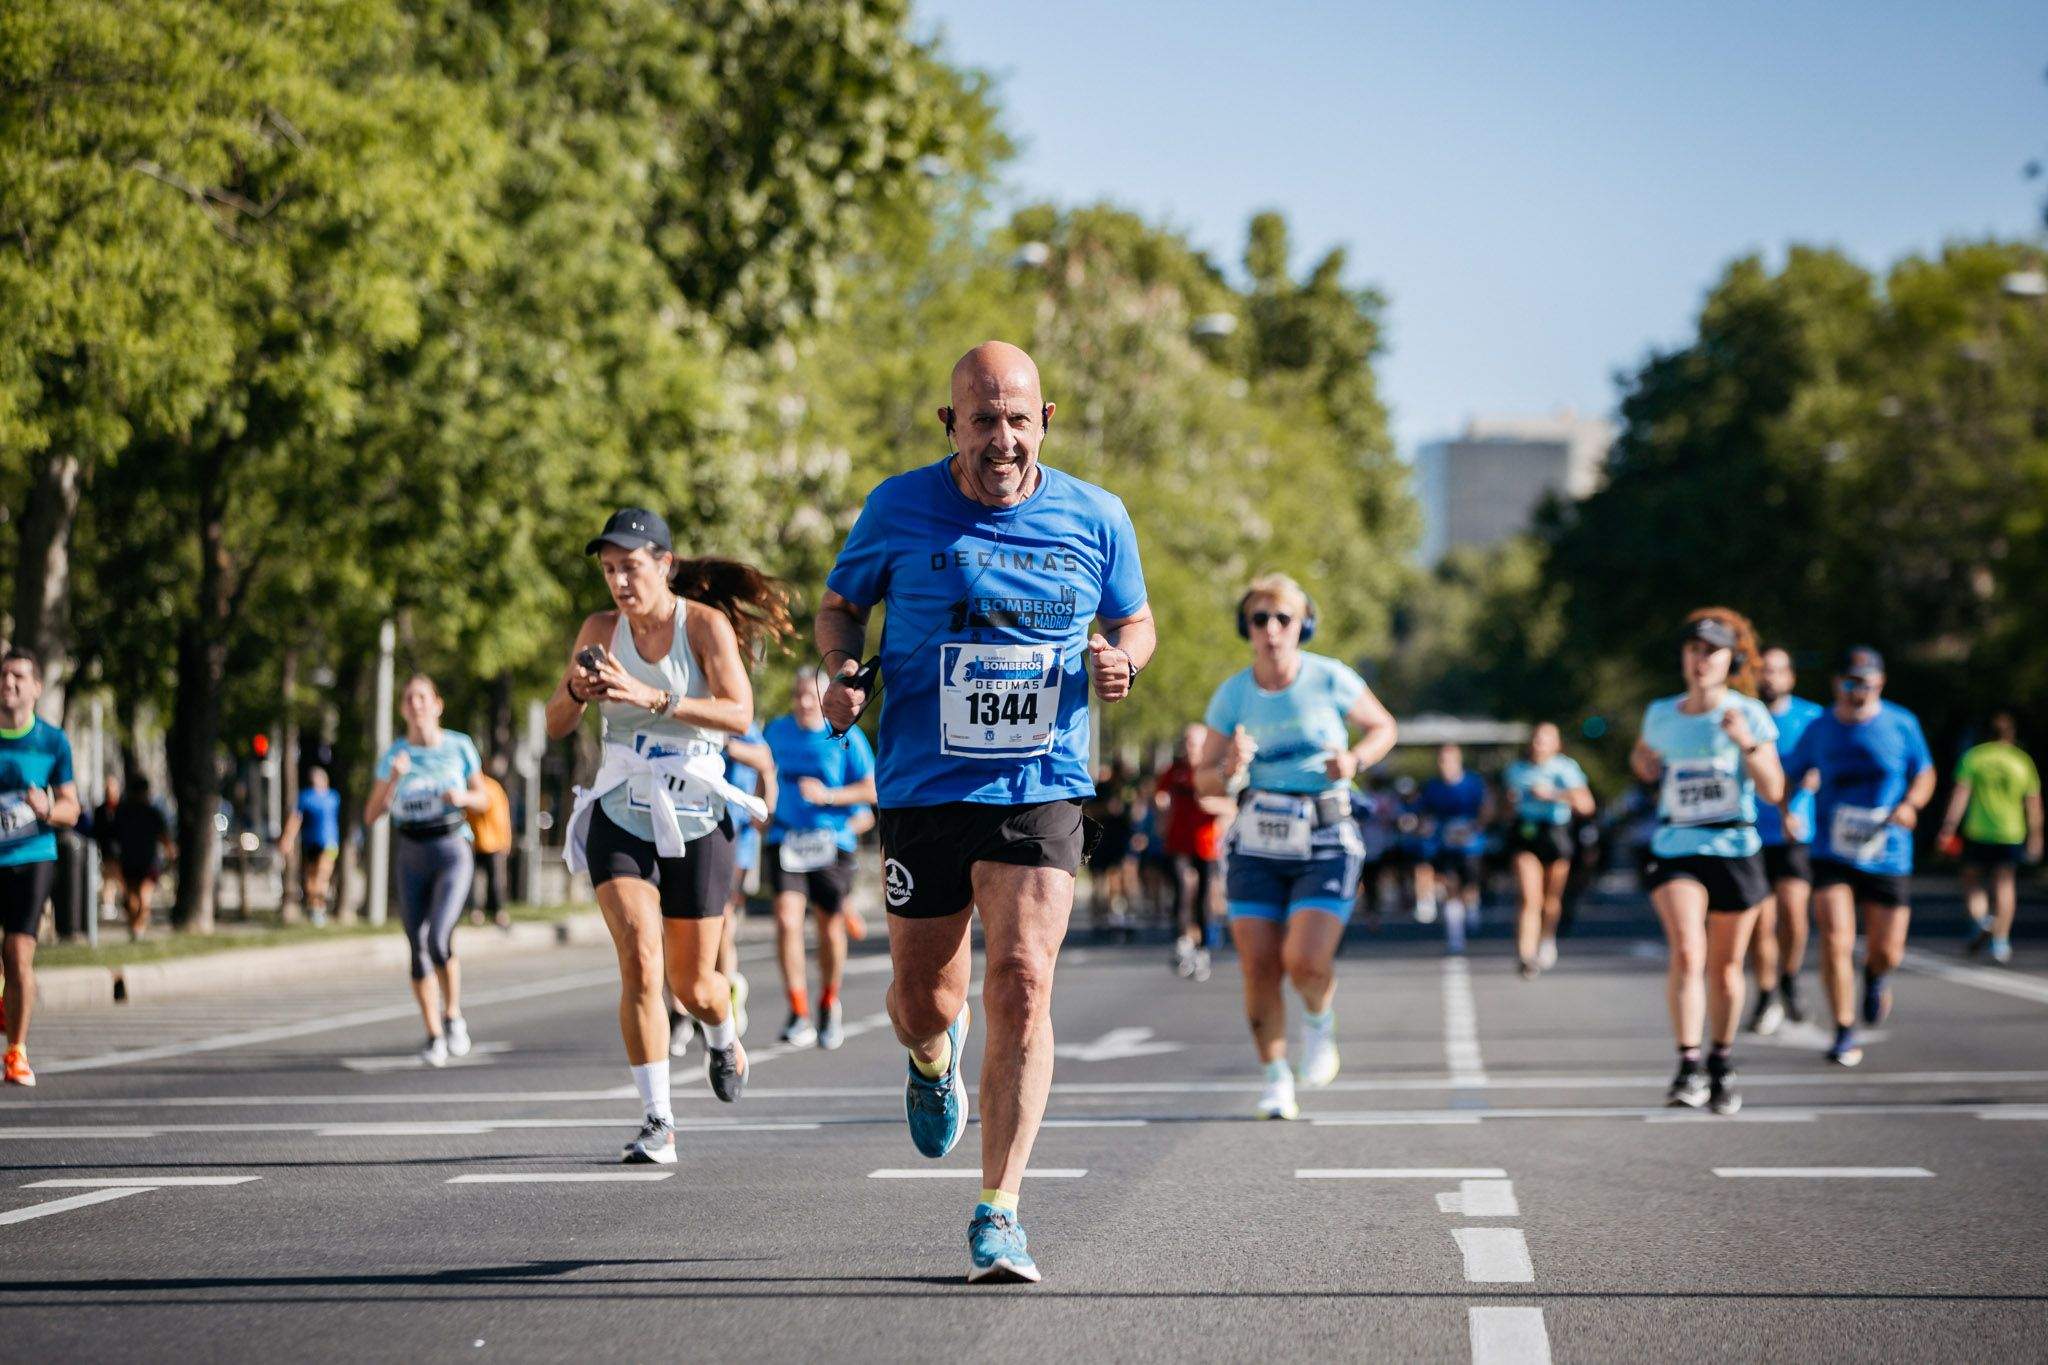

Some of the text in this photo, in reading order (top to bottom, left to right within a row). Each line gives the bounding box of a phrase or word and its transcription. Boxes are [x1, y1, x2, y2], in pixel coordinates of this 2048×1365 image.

[931, 551, 1078, 572] DECIMAS
[981, 599, 1073, 615] BOMBEROS
[1018, 613, 1071, 630] de MADRID
[983, 661, 1042, 671] BOMBEROS
[976, 681, 1039, 690] DECIMAS
[966, 693, 1038, 726] 1344
